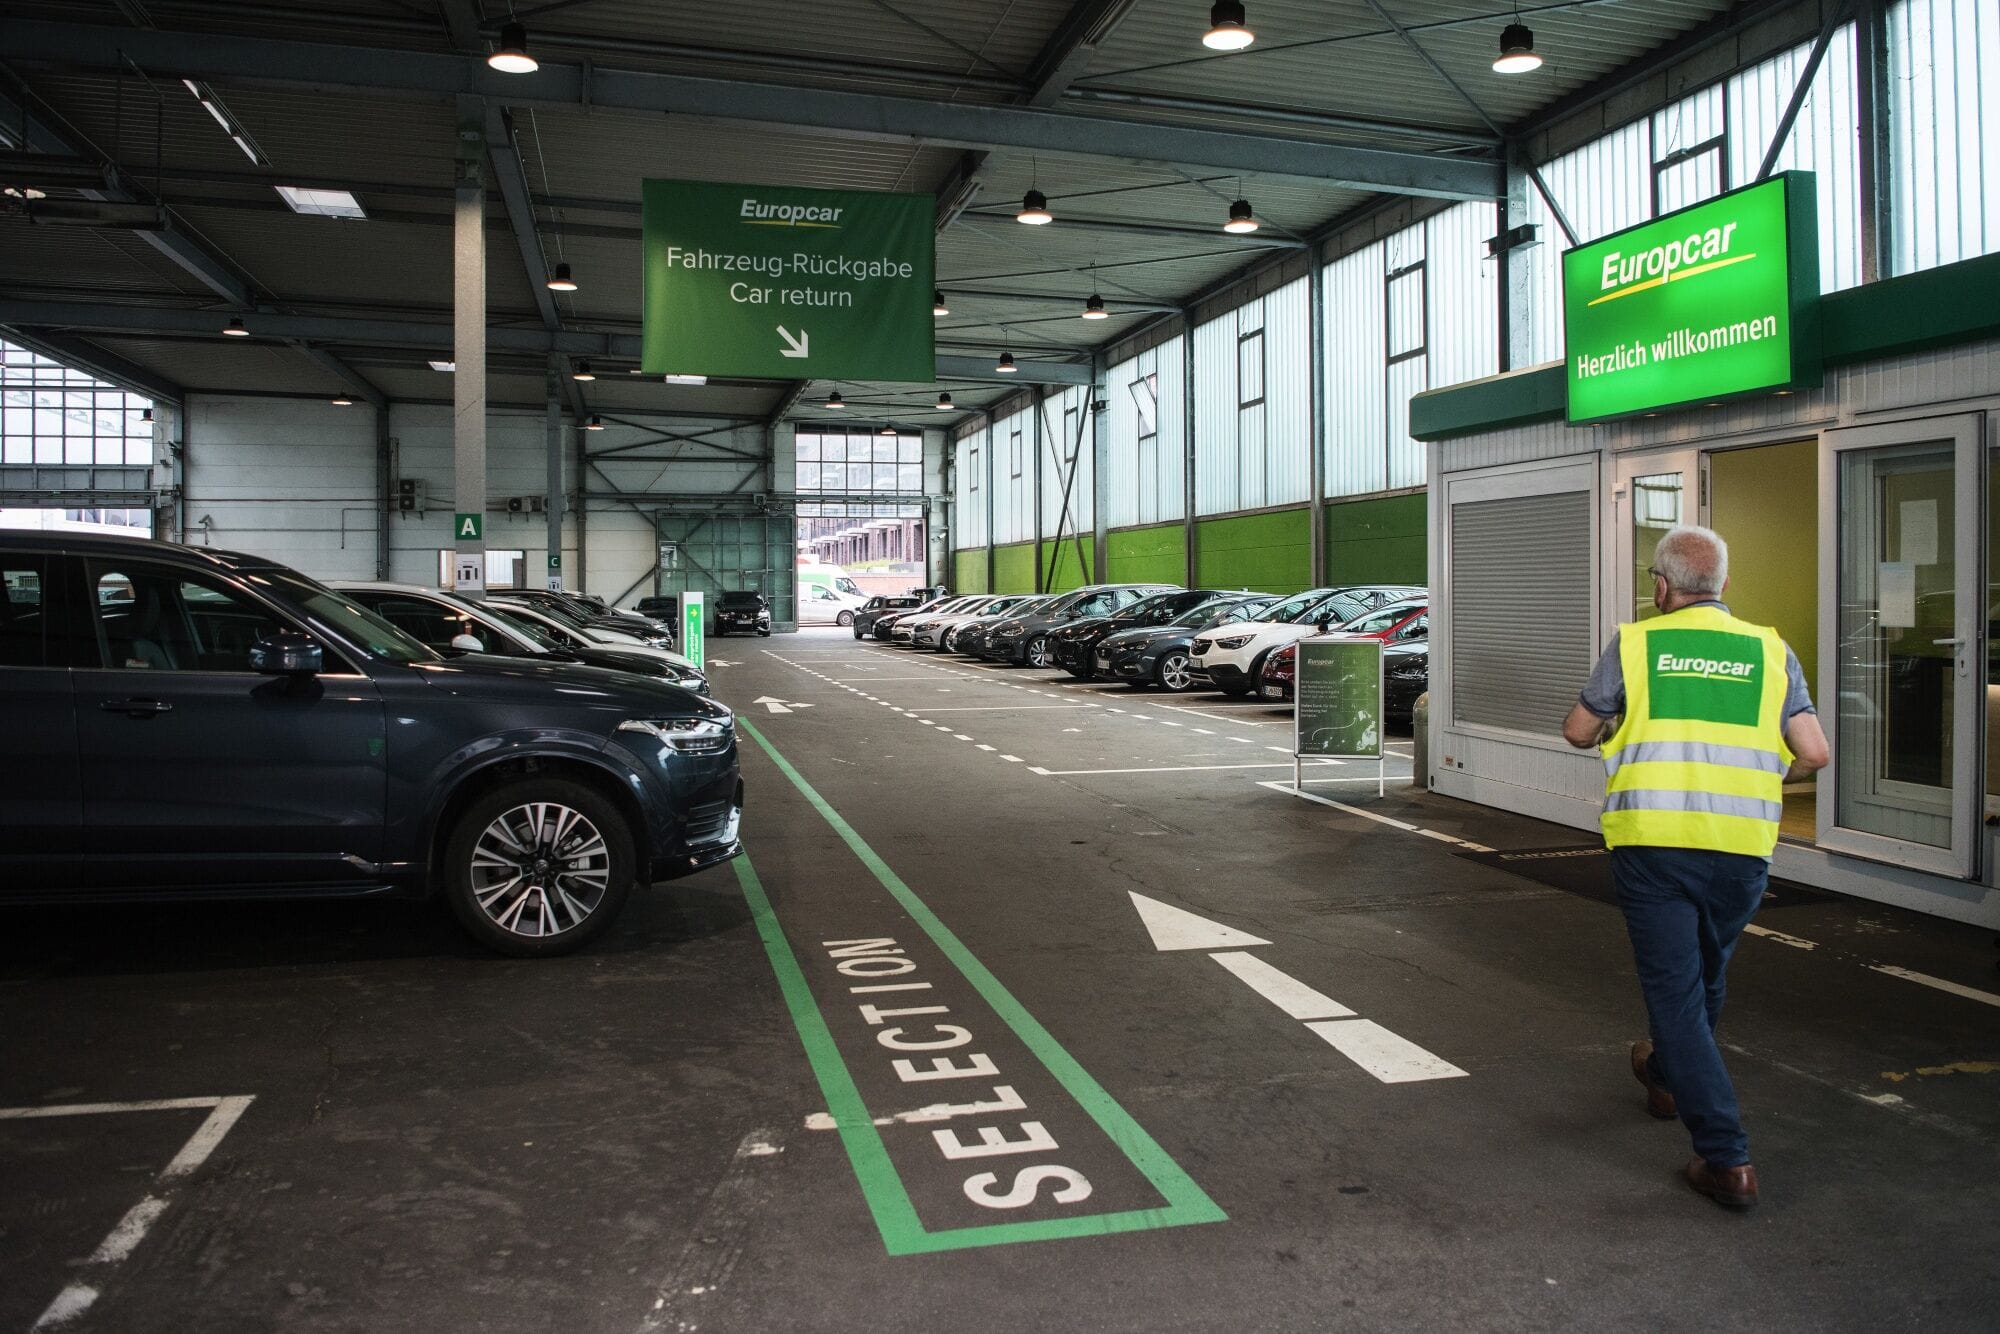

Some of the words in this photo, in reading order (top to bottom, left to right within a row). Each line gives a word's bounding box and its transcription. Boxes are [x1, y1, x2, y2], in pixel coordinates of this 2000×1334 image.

[740, 199, 843, 226] Europcar
[667, 247, 913, 280] Fahrzeug-Rückgabe
[1601, 221, 1737, 290] Europcar
[730, 282, 773, 304] Car
[781, 286, 852, 307] return
[1577, 340, 1647, 379] Herzlich
[1651, 315, 1776, 362] willkommen
[461, 518, 476, 536] A
[551, 557, 558, 567] C
[1656, 653, 1755, 679] Europcar
[822, 937, 1093, 1209] SELECTION
